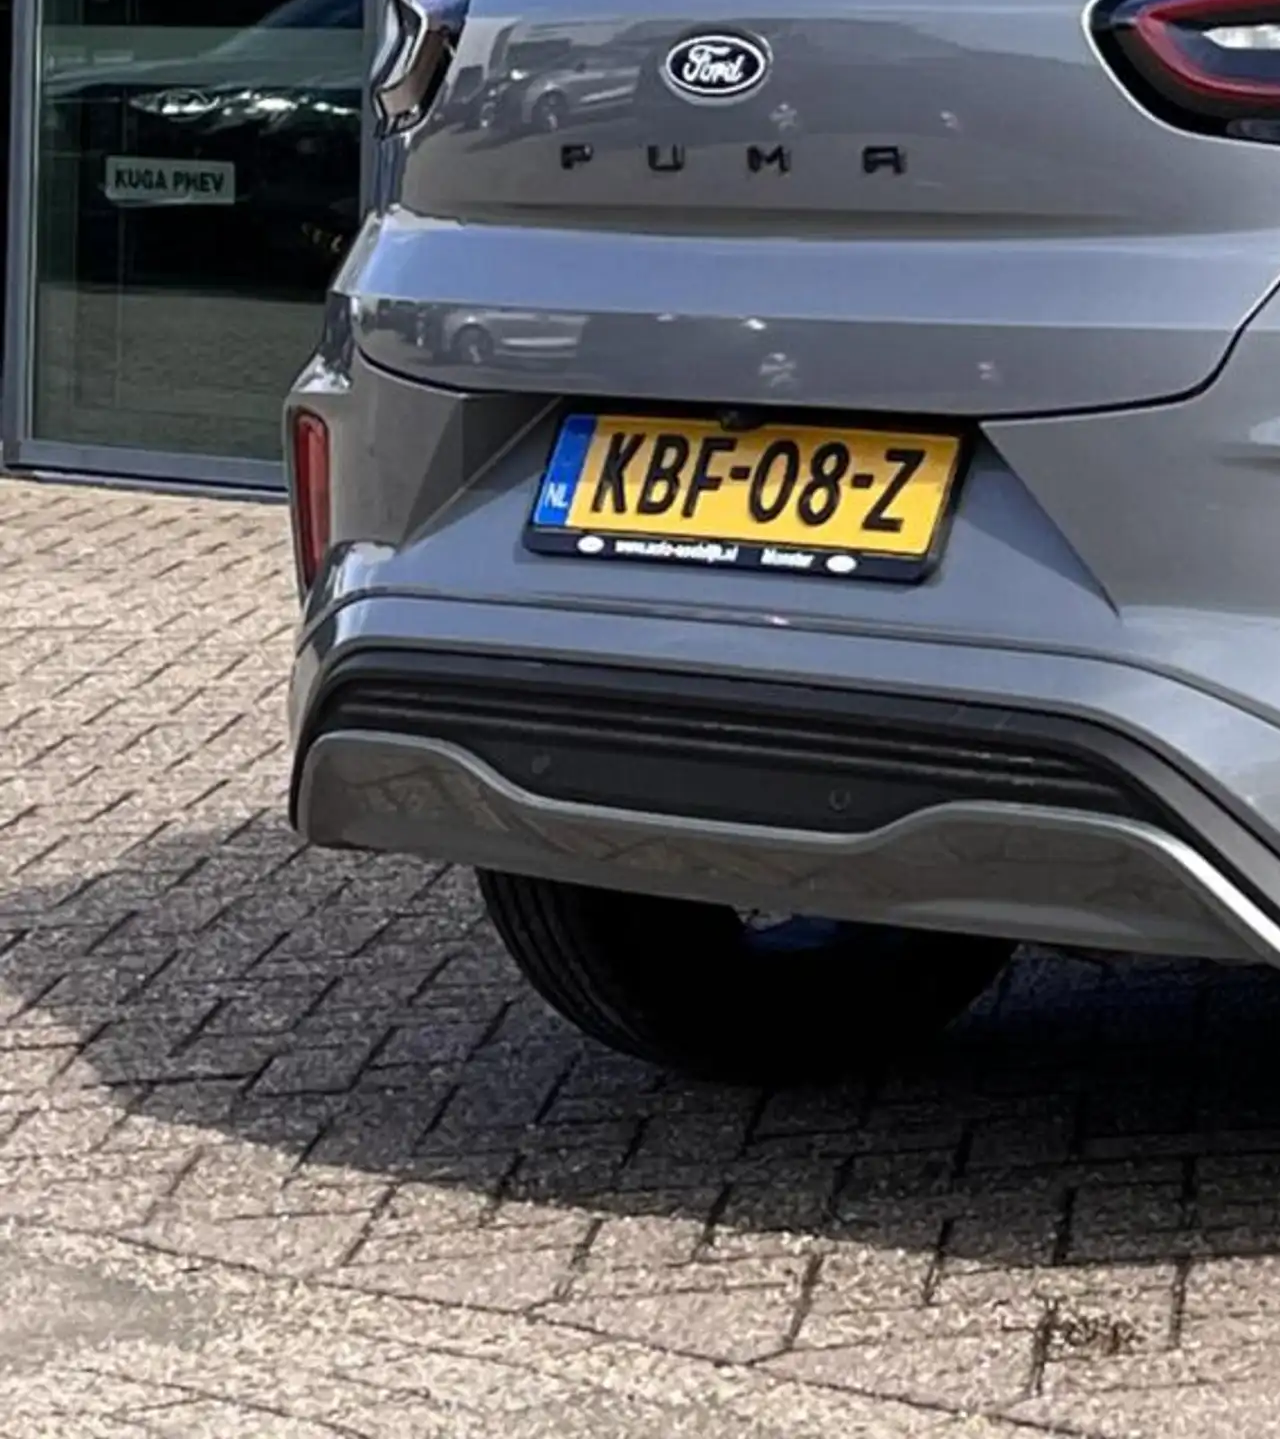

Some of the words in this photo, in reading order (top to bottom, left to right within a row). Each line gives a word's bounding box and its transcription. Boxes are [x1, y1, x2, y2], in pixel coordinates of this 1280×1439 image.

[682, 43, 748, 85] Ford
[559, 142, 908, 176] PUMA
[114, 167, 169, 192] KUGA
[171, 170, 225, 195] PHEV
[543, 481, 570, 509] NL
[589, 430, 927, 534] KBF-08-Z
